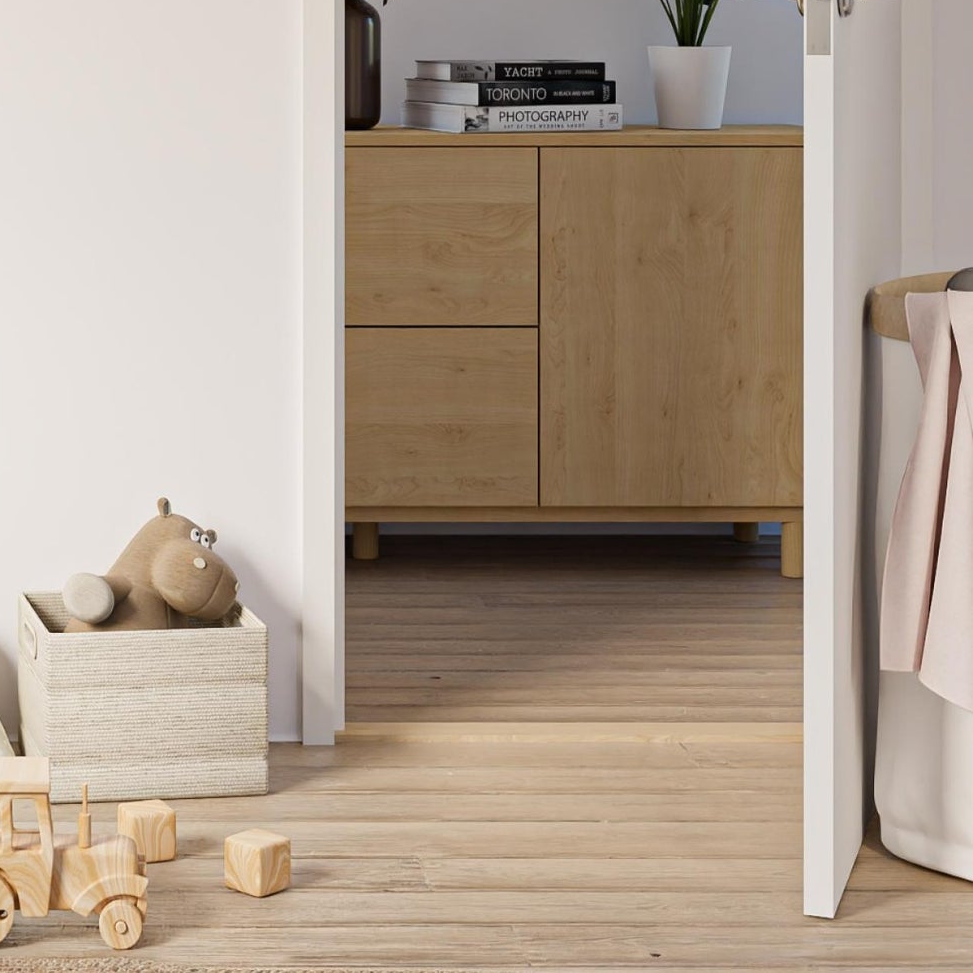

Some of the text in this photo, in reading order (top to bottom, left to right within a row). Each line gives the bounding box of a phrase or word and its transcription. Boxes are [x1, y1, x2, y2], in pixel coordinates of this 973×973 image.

[503, 67, 544, 78] YACHT
[486, 87, 547, 101] TORONTO
[499, 110, 589, 122] PHOTOGRAPHY
